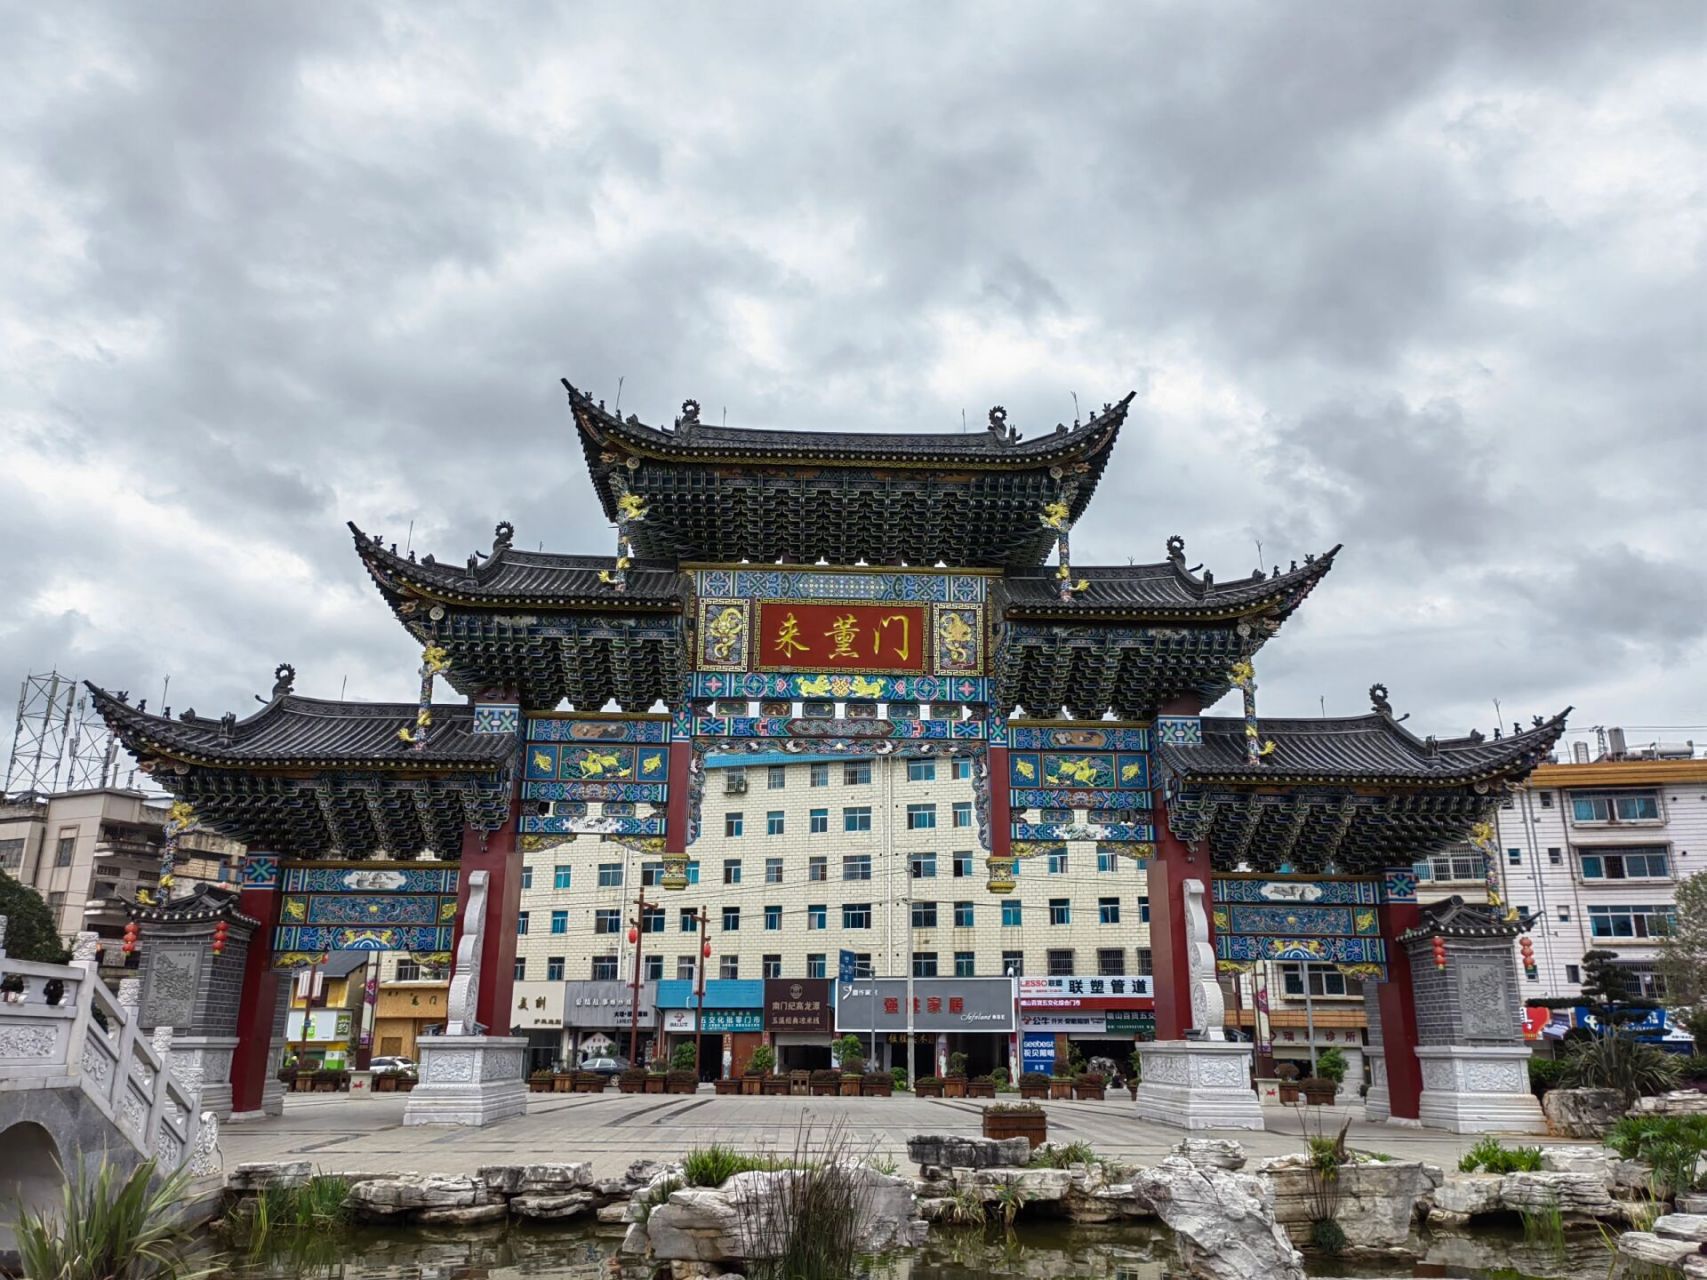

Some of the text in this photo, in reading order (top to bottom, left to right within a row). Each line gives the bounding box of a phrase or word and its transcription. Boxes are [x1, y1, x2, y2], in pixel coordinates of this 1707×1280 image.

[774, 612, 910, 661] 来薰门
[1069, 979, 1148, 995] 联塑管道
[1032, 1016, 1050, 1024] 公牛
